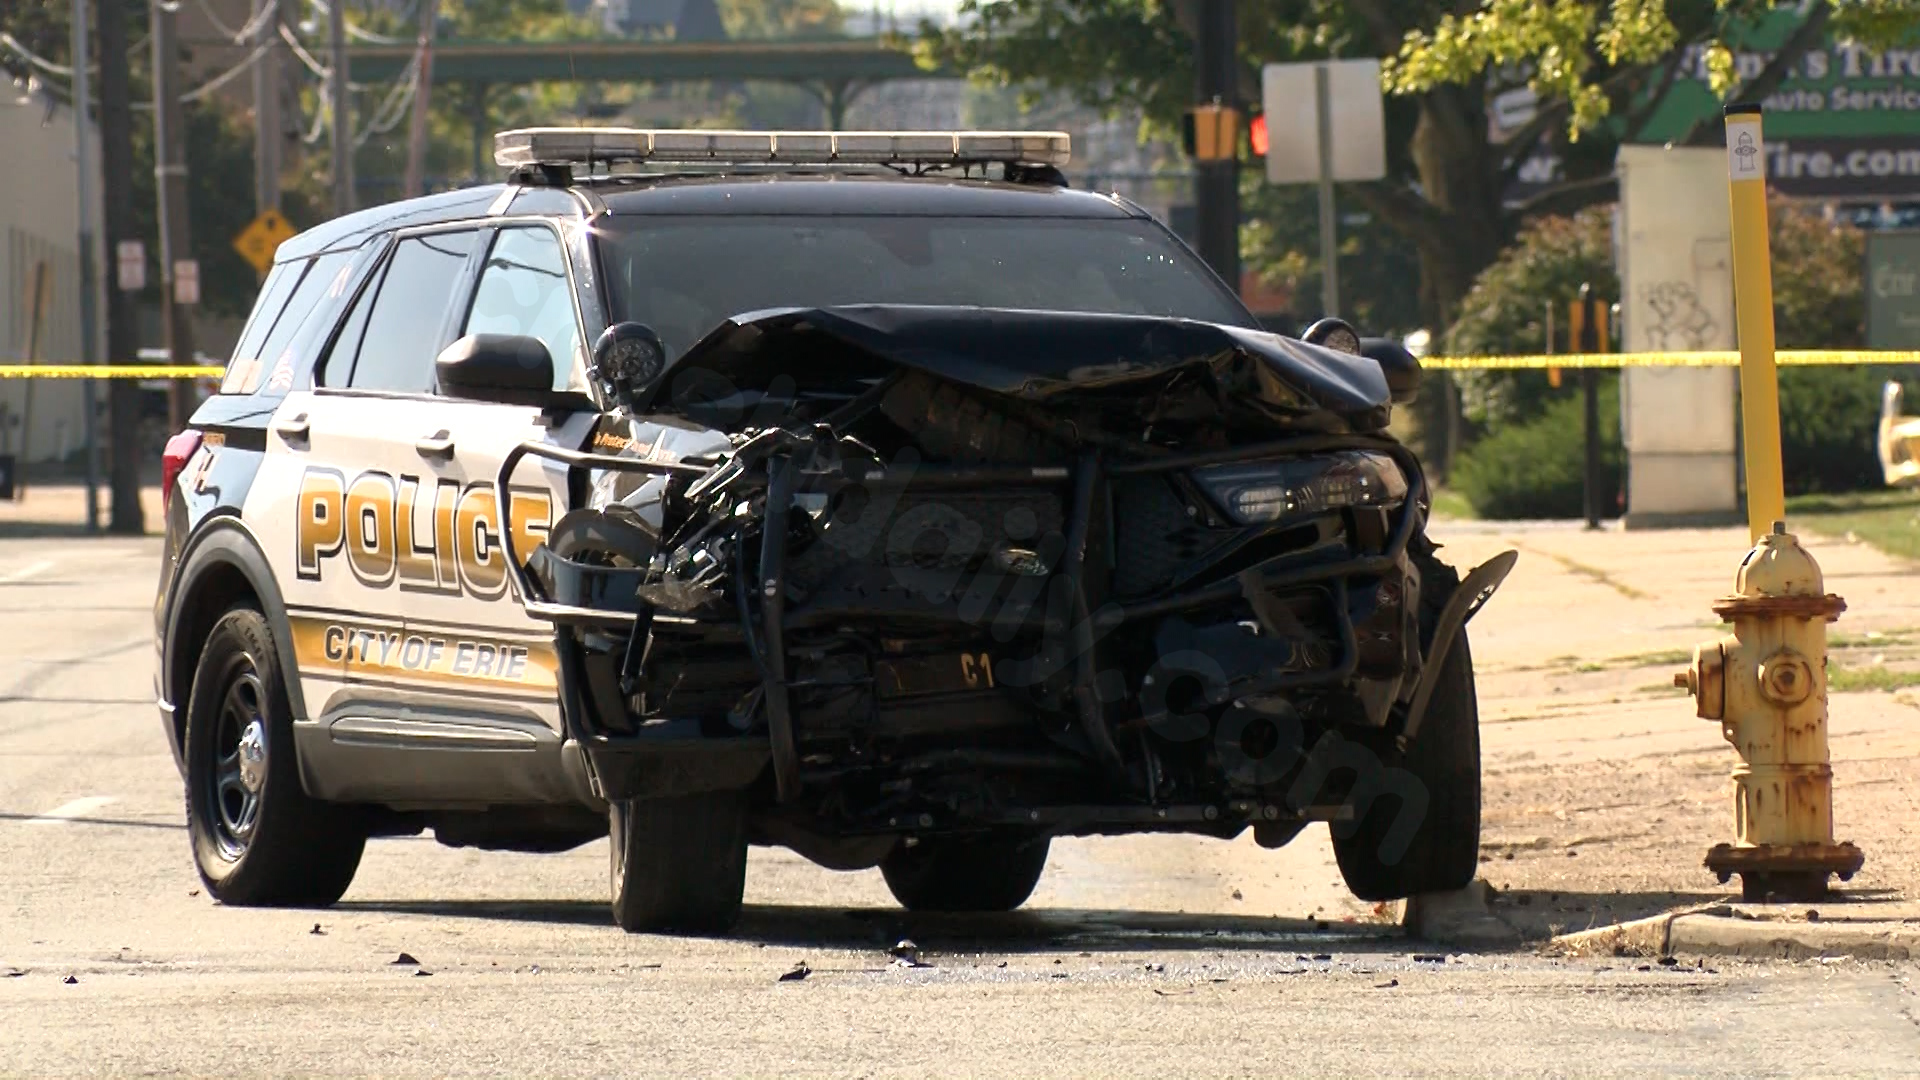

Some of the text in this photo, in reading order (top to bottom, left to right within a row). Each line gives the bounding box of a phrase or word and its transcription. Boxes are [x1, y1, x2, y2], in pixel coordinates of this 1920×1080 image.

[1831, 85, 1920, 112] Servic
[296, 466, 552, 600] POLICE
[323, 625, 528, 679] CITY OF ERIE
